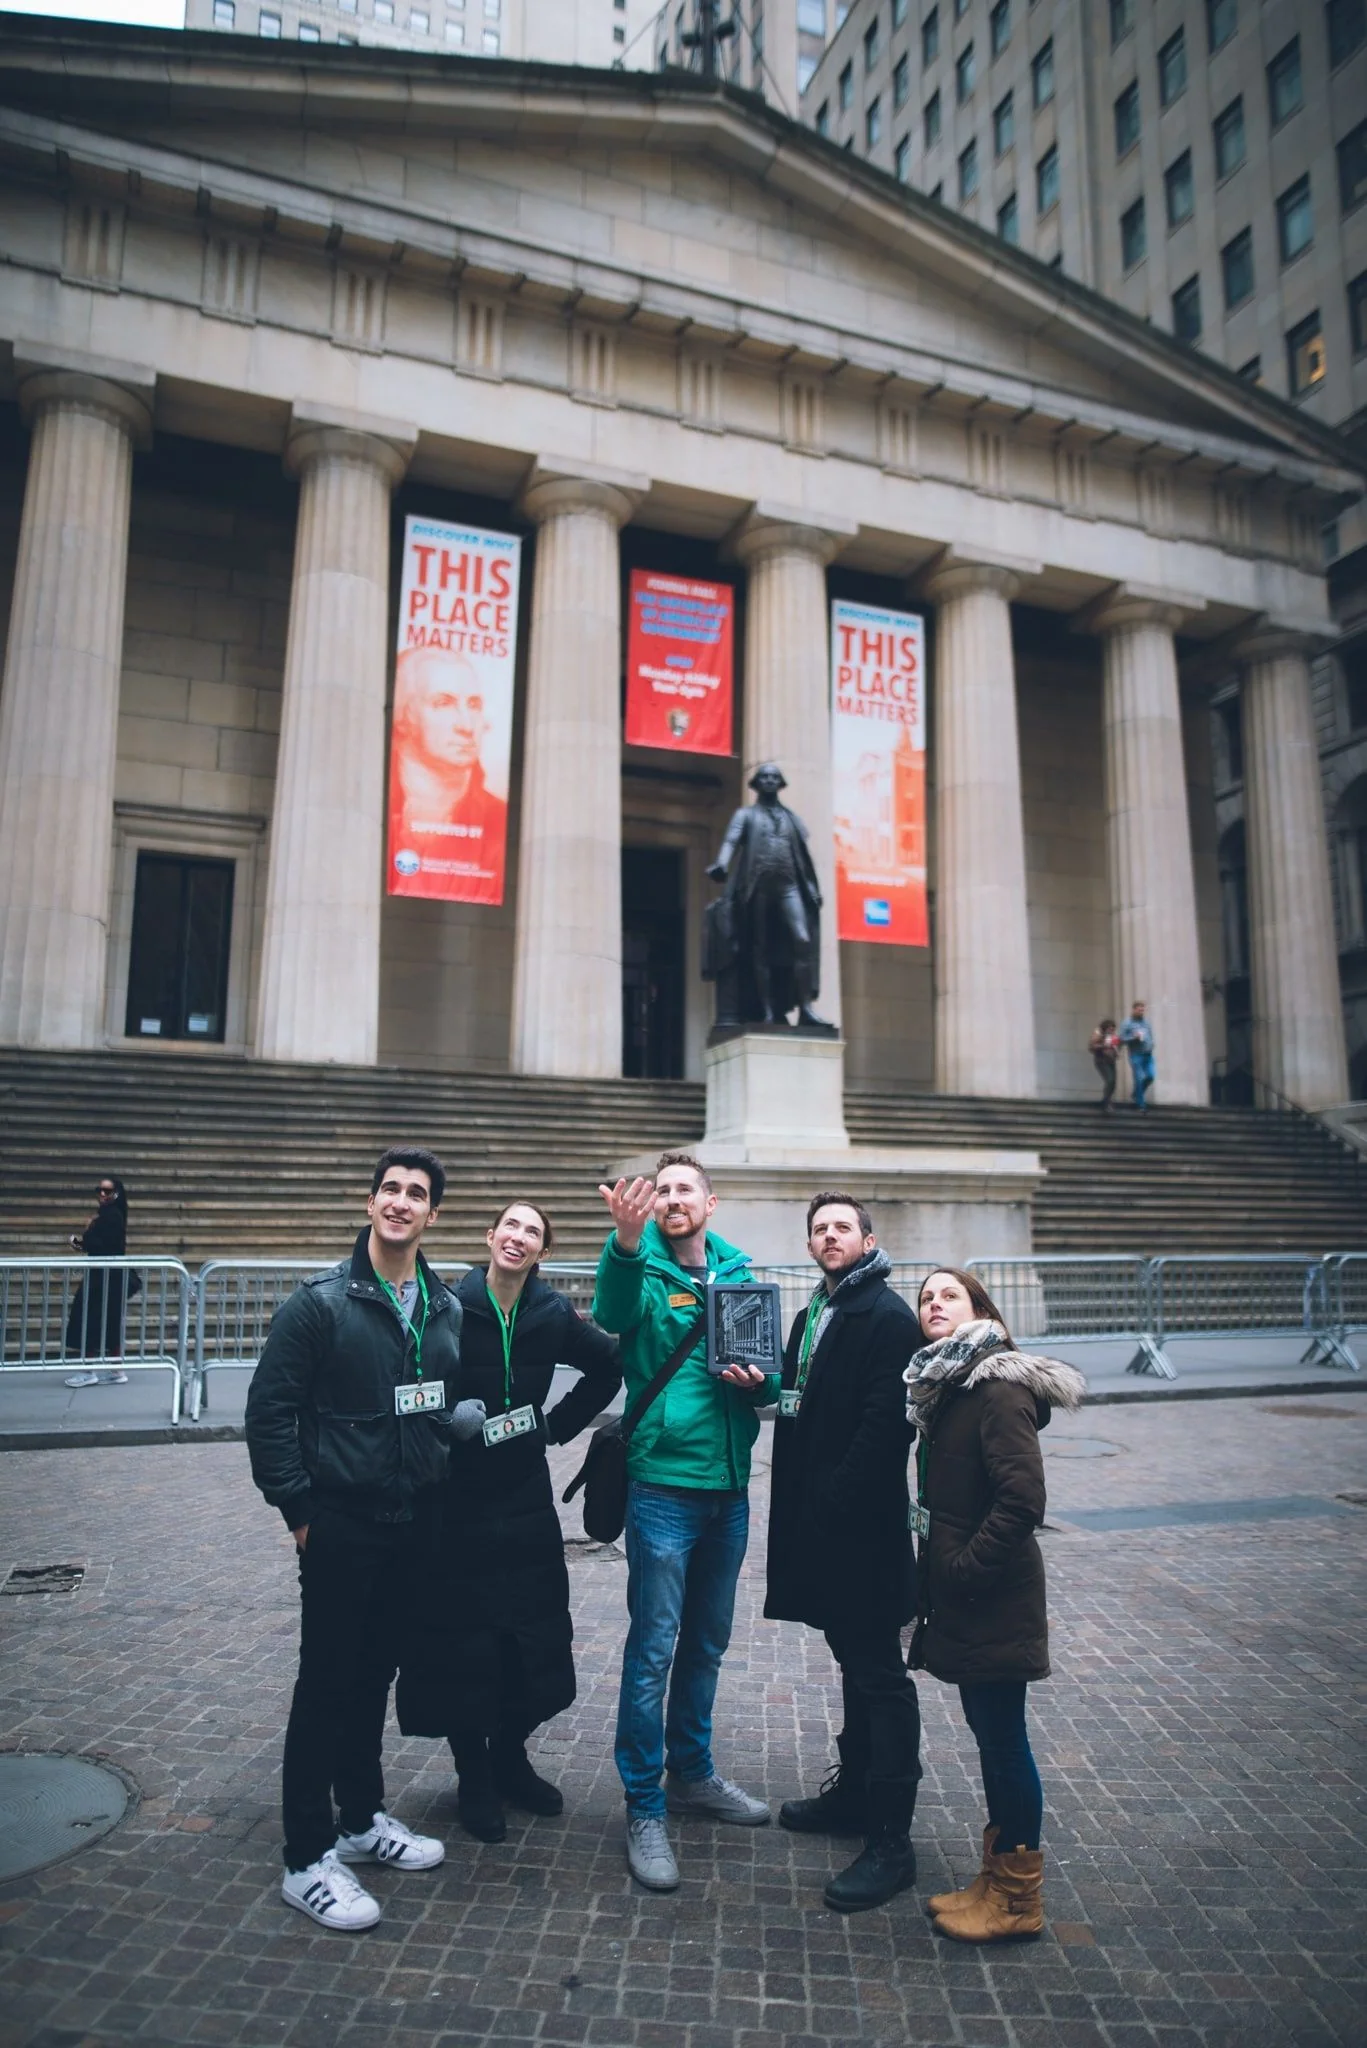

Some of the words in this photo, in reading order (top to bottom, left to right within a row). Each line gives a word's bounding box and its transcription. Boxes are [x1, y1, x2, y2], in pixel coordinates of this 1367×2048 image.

[411, 544, 511, 600] THIS
[408, 590, 509, 634] PLACE
[406, 623, 509, 658] MATTERS
[838, 624, 918, 673] THIS
[838, 665, 918, 704] PLACE
[836, 695, 918, 725] MATTERS
